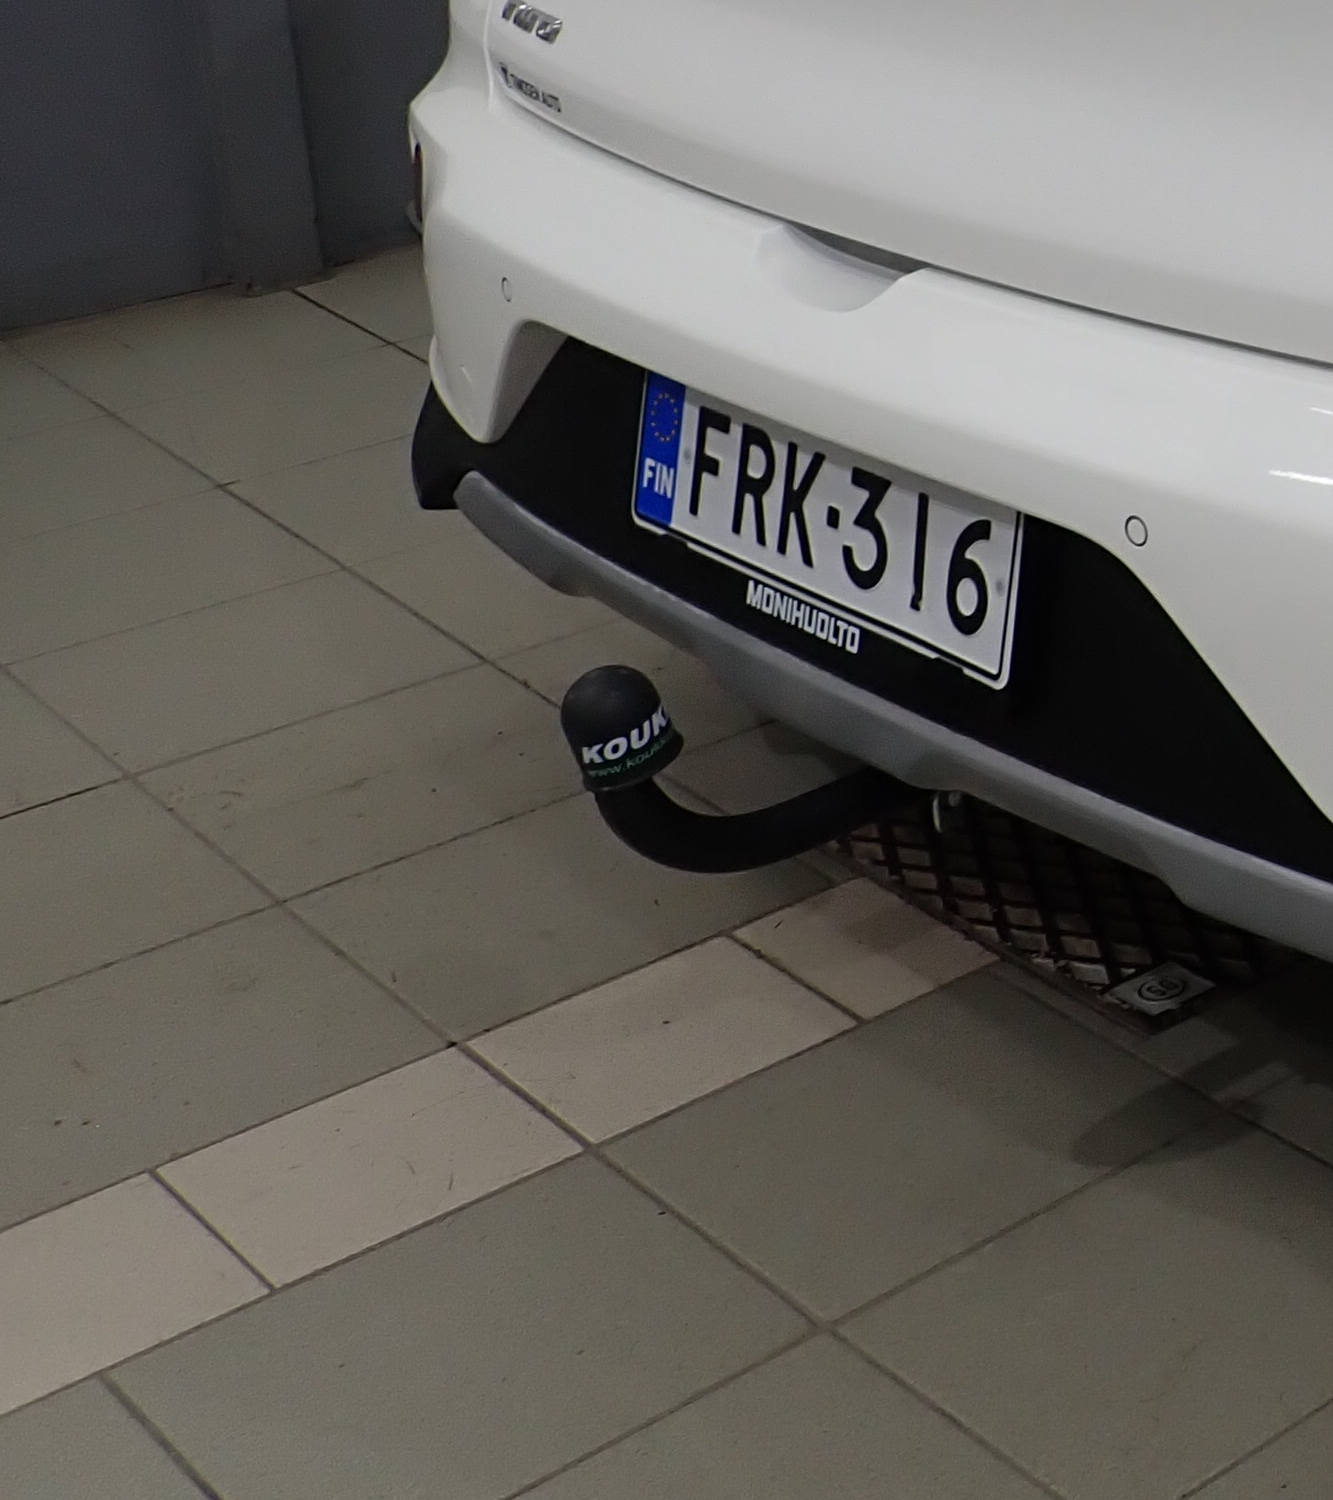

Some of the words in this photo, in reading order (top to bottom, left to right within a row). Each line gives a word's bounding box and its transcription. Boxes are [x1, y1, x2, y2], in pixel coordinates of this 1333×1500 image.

[643, 457, 675, 499] FIN
[689, 406, 992, 636] FRK-316
[745, 579, 861, 654] MONIHUOLTO
